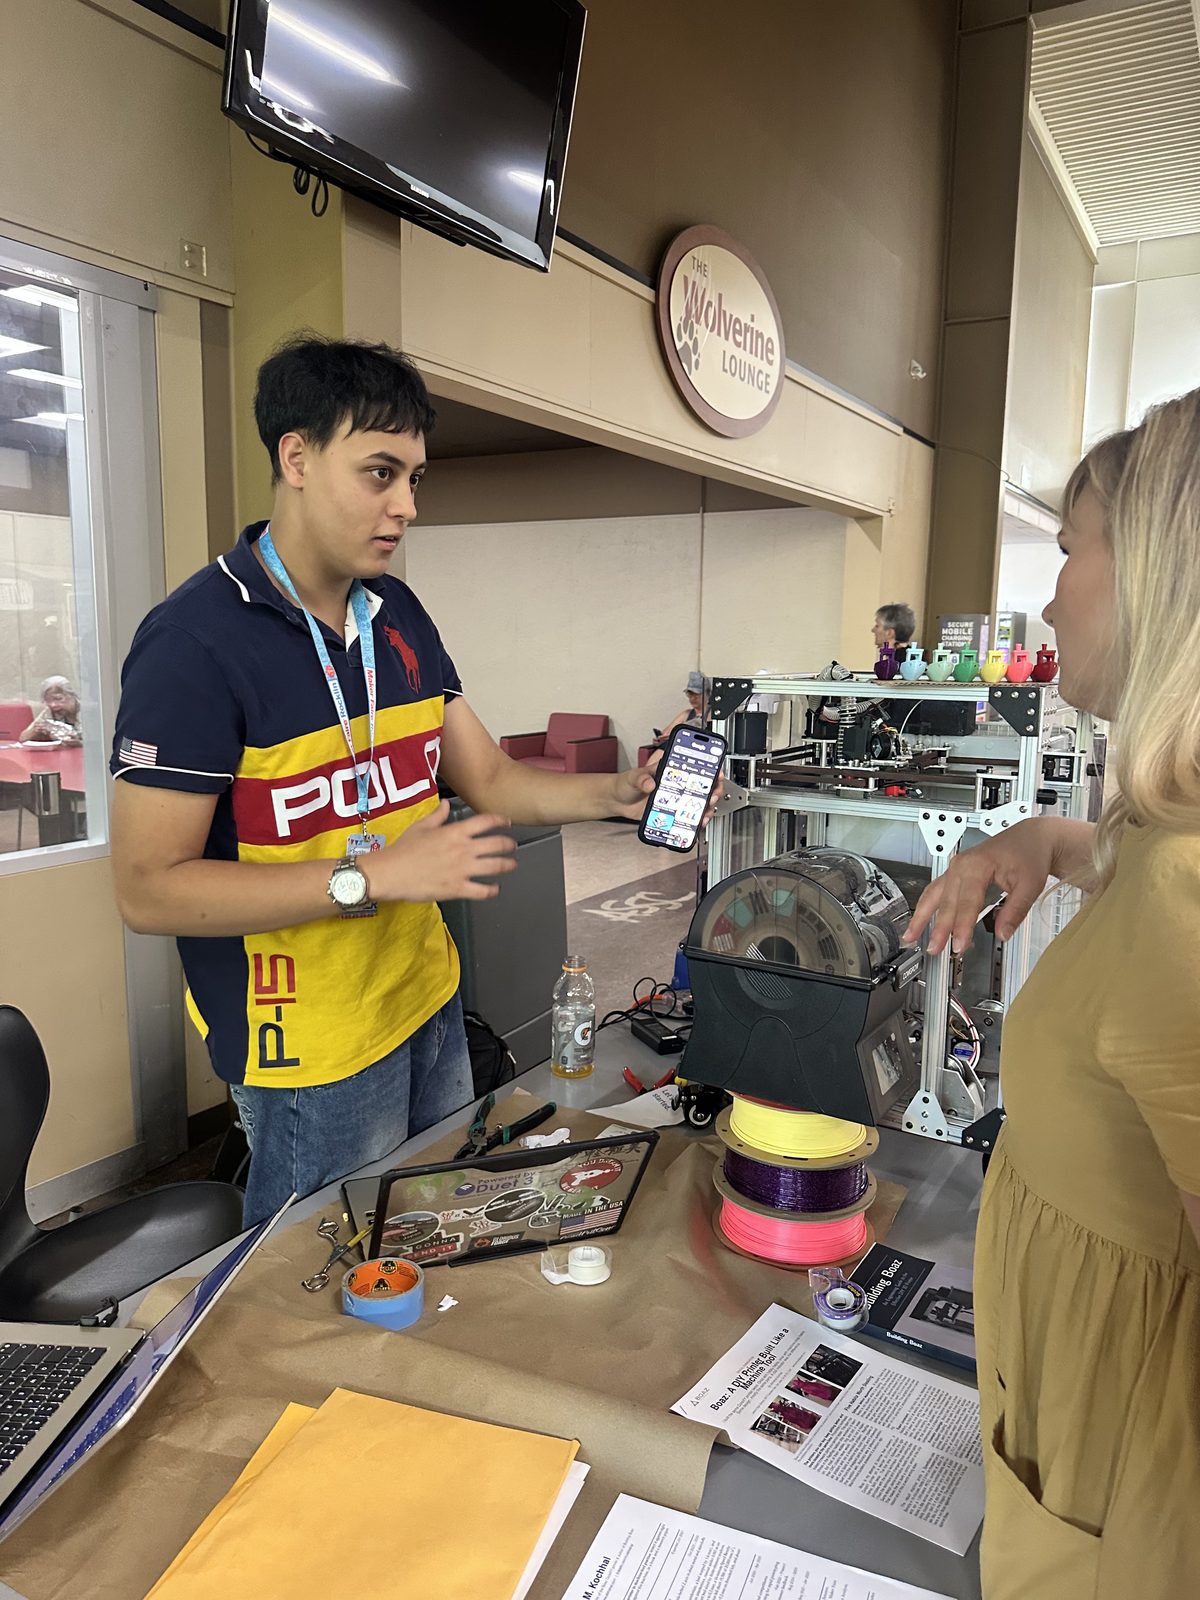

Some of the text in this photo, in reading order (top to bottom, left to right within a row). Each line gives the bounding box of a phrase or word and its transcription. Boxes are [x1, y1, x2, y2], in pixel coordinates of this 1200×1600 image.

[692, 256, 708, 278] THE
[683, 275, 774, 366] Wolverine
[722, 350, 770, 394] LOUNGE
[366, 669, 375, 698] Maker
[332, 682, 347, 719] Rocklin
[253, 953, 300, 1069] P-15
[475, 1176, 534, 1193] Duet 3
[478, 1171, 536, 1185] Powered by
[595, 1205, 608, 1213] THE
[609, 1201, 624, 1209] USA
[415, 1236, 457, 1250] GONNA
[442, 1244, 454, 1252] IT
[881, 1259, 903, 1278] Boaz
[886, 1331, 923, 1348] Building Boaz
[710, 1393, 731, 1411] Boaz:
[732, 1374, 745, 1388] DIY
[742, 1358, 763, 1377] Printer
[759, 1344, 775, 1359] Built
[770, 1332, 785, 1345] Like
[740, 1355, 777, 1390] Machine Tool
[582, 1556, 611, 1600] M. Kochhal
